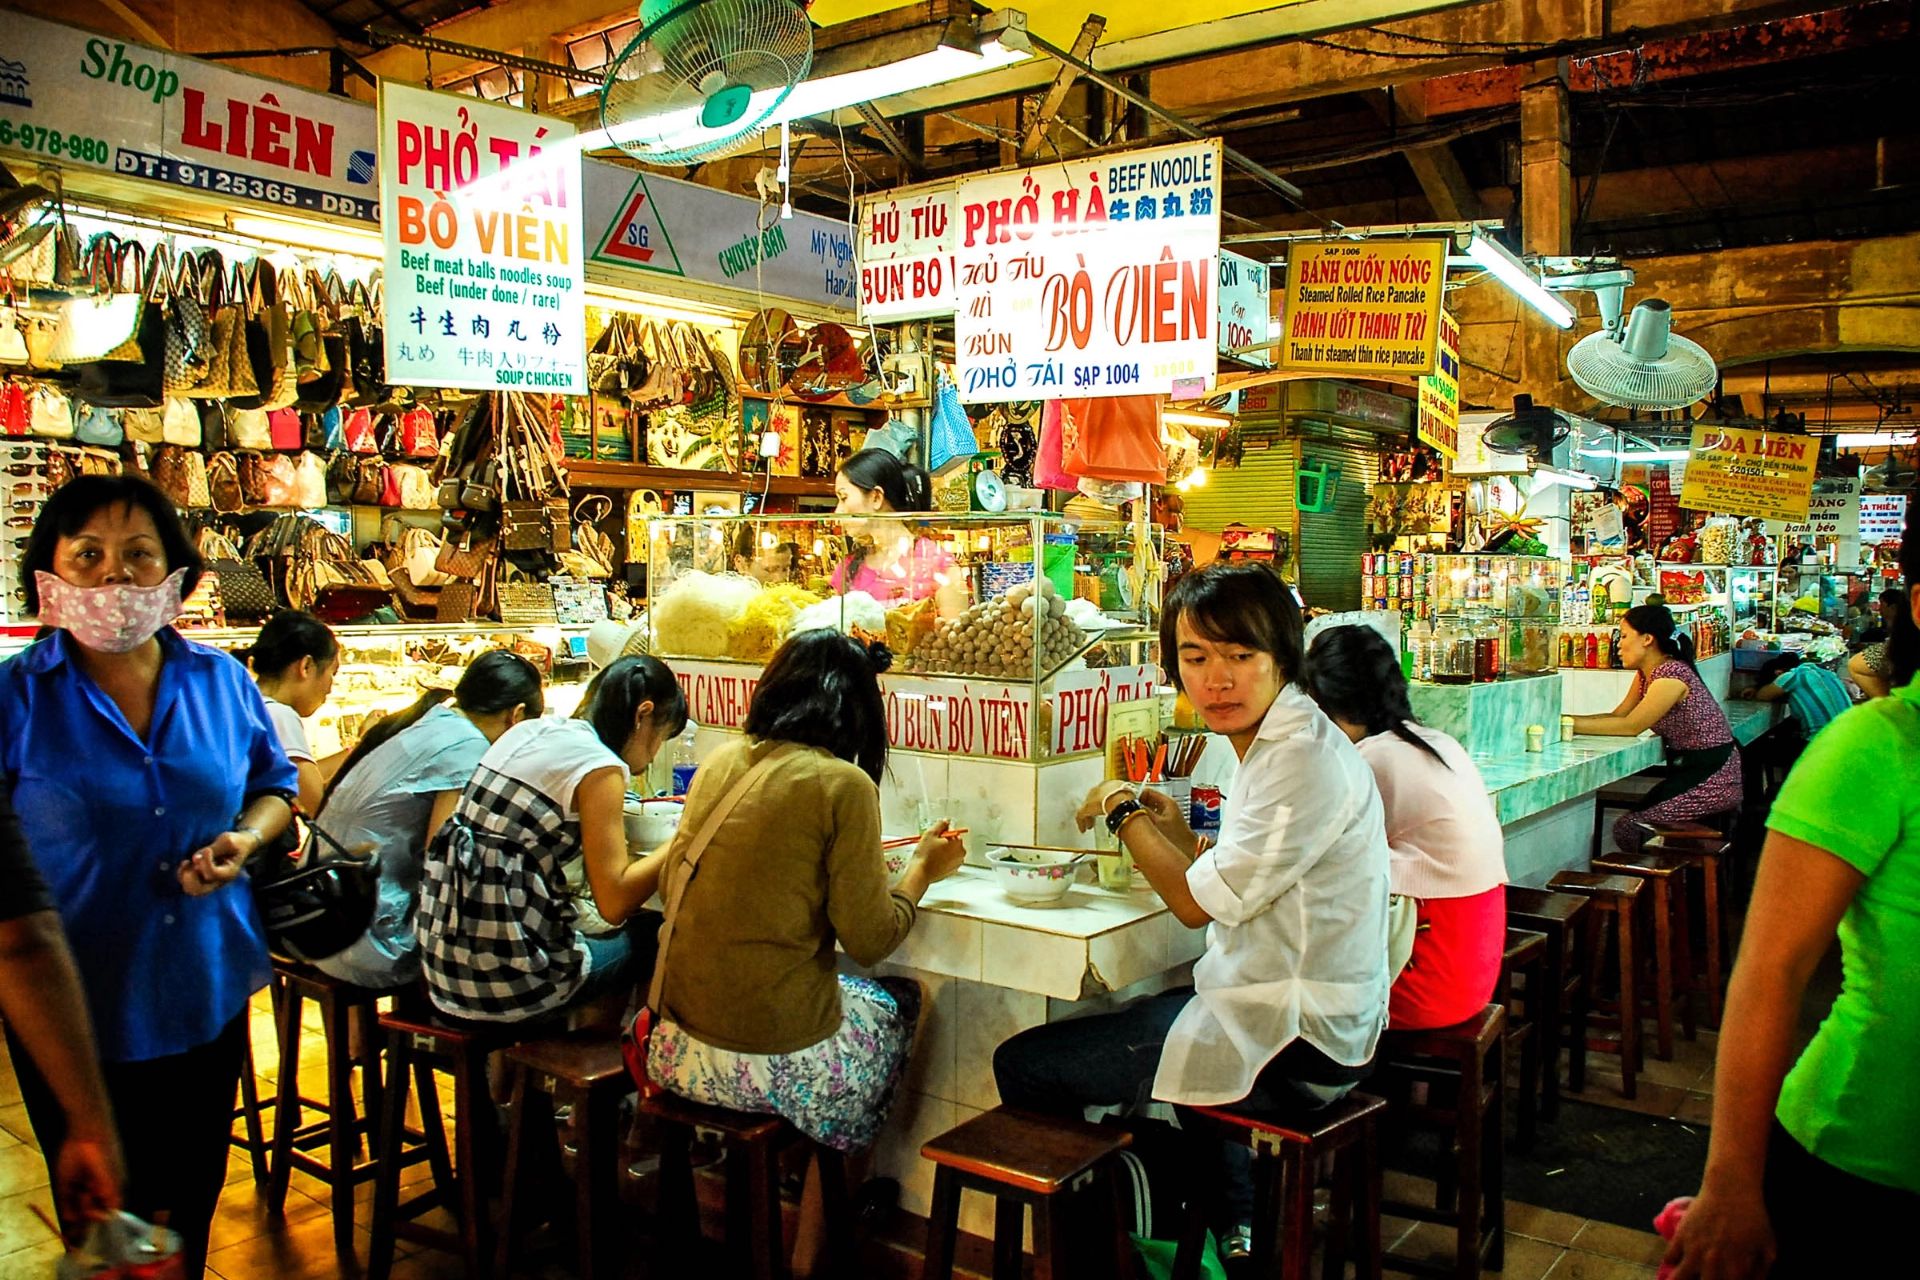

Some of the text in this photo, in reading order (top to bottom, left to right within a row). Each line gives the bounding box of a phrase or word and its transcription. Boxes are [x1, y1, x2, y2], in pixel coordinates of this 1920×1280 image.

[80, 38, 179, 104] Shop
[181, 87, 335, 178] LIÊN
[397, 106, 480, 195] PHỞ
[117, 151, 169, 180] ĐT:
[178, 164, 297, 206] 9125365
[1108, 153, 1213, 195] BEEF NOODLE
[397, 191, 570, 266] BÒ VIÊN
[871, 200, 900, 246] HỦ
[963, 171, 1109, 248] PHỞ HÀ
[401, 249, 573, 293] Beef meat balls noodles soup
[912, 245, 943, 299] BÒ
[961, 252, 998, 287] HỦ
[1300, 253, 1432, 284] BÁNH CUỐN NÓNG
[1341, 247, 1361, 256] 1006
[416, 273, 445, 295] Beef
[449, 277, 488, 301] (under
[492, 284, 519, 304] done
[532, 291, 561, 311] rare)
[1040, 245, 1209, 352] BÒ VIÊN
[1299, 286, 1426, 304] Steamed Rolled Rice Pancake
[963, 327, 1012, 357] BÚN
[1292, 306, 1328, 339] BÁNH
[1358, 311, 1402, 341] THANH
[1404, 309, 1428, 342] TRÌ
[963, 356, 1018, 394] PHỞ
[1024, 357, 1064, 388] TÁI
[1105, 362, 1140, 386] 1004
[1291, 342, 1313, 361] Thanh
[1326, 344, 1357, 363] steamed
[1358, 345, 1374, 364] thin
[1375, 346, 1390, 364] rice
[1392, 346, 1426, 368] pancake
[495, 369, 525, 386] SOUP
[1703, 433, 1806, 460] HOA LIÊN
[1729, 465, 1765, 477] 5201501
[947, 684, 974, 754] BÒ
[979, 688, 1029, 759] VIÊN
[1056, 670, 1111, 755] PHỞ
